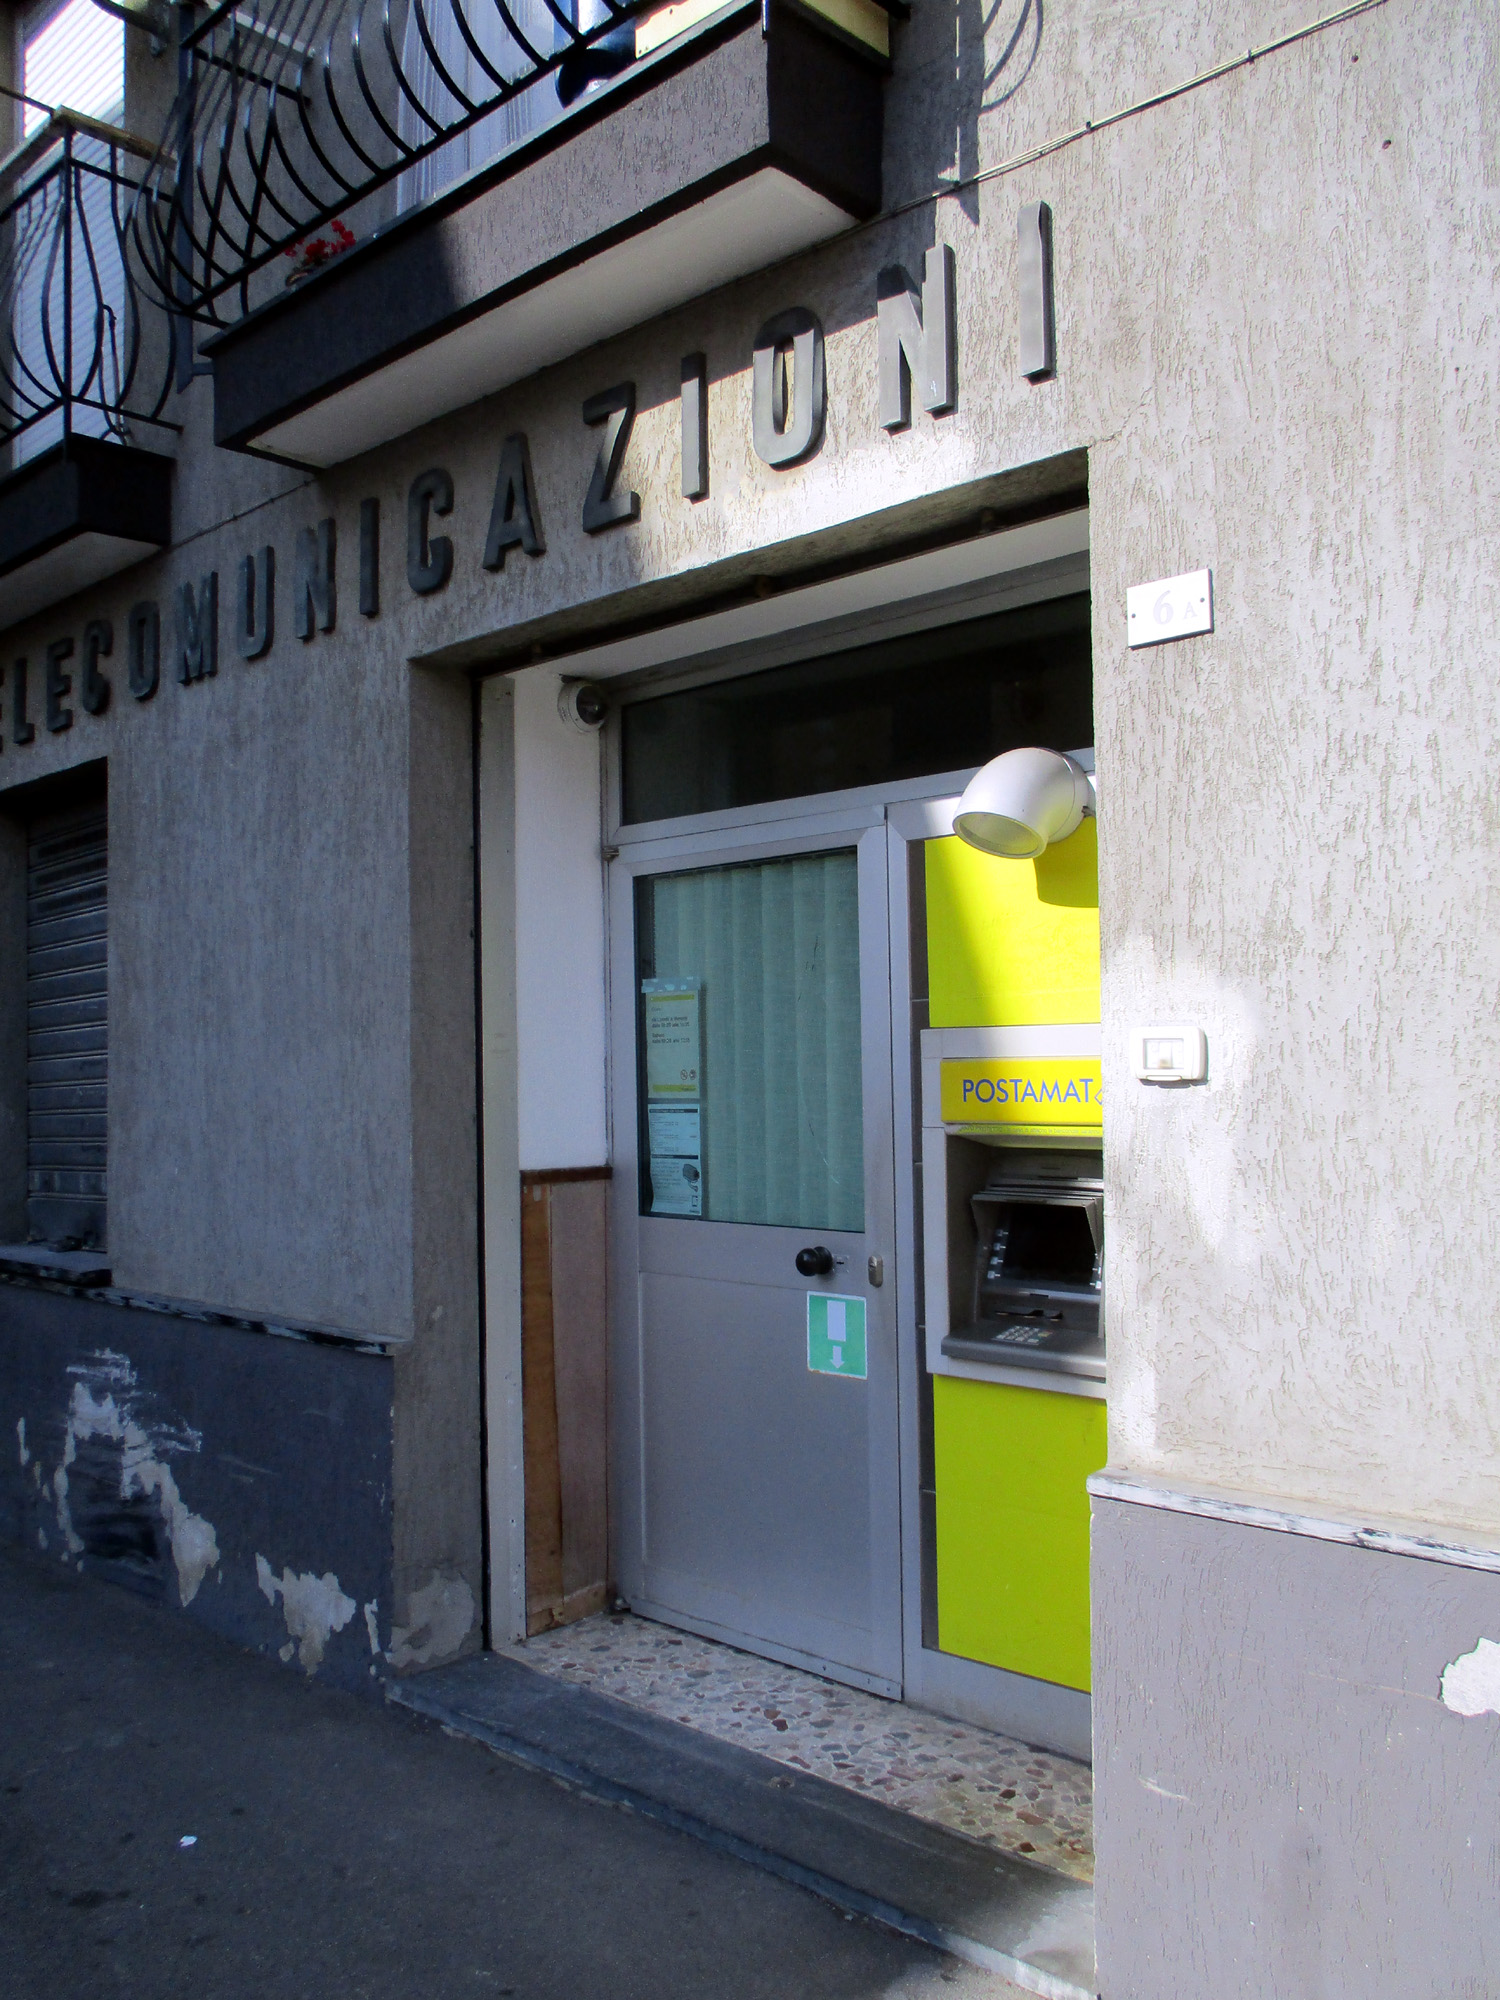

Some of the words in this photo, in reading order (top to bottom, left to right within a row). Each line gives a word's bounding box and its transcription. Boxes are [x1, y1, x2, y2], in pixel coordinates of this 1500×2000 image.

[0, 200, 1056, 755] LECOMUNICAZIONI
[1152, 589, 1175, 625] 6
[962, 1078, 1093, 1103] POSTAMAT
